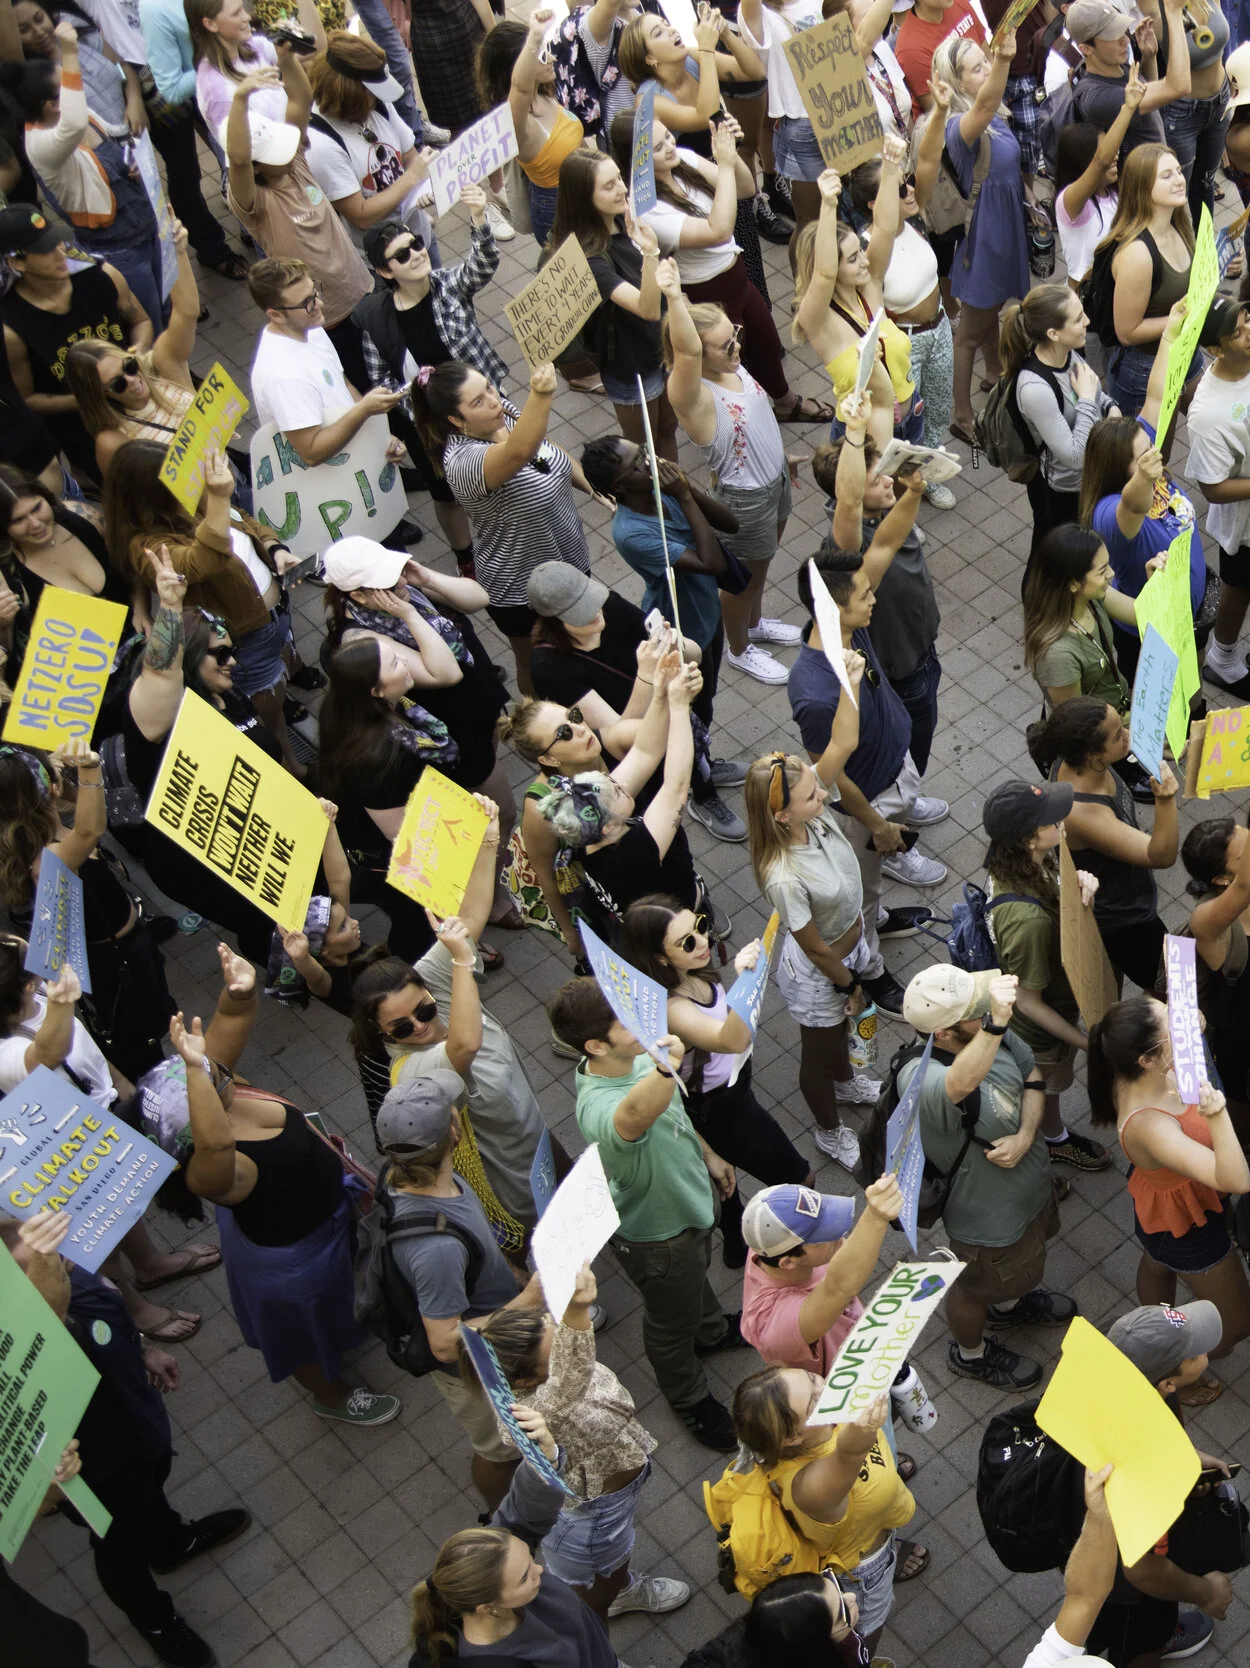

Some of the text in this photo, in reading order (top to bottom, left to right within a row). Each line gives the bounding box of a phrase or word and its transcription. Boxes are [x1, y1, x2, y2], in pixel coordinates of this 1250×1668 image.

[436, 110, 503, 178] PLANET
[446, 130, 512, 204] PROFIT
[457, 153, 477, 173] OVER
[510, 256, 566, 321] THERE'S NO
[515, 264, 580, 339] TIME TO WAIT
[524, 308, 561, 354] EVERY
[562, 297, 572, 312] 4
[529, 341, 555, 368] FOR
[166, 371, 225, 483] STAND FOR
[18, 618, 77, 731] NETZERO
[53, 628, 116, 737] SDSU!
[1206, 741, 1222, 765] A
[1210, 712, 1242, 736] NO
[159, 749, 200, 831] CLIMATE
[185, 784, 220, 851] CRISIS
[207, 804, 245, 870] WON'T
[235, 812, 272, 891] NEITHER
[259, 831, 297, 908] WILL WE.
[1167, 939, 1194, 1094] STUDENTS
[1185, 963, 1208, 1083] CHANGE
[9, 1113, 102, 1209] CLIMATE
[20, 1135, 53, 1167] GLOBAL
[40, 1125, 121, 1214] ALKOUT
[75, 1167, 117, 1212] SAN DIEGO
[70, 1152, 148, 1245] YOUTH DEMAND
[83, 1160, 159, 1253] CLIMATE ACTION
[20, 1331, 46, 1378] POWER
[818, 1337, 879, 1414] LOVE
[857, 1267, 928, 1333] YOUR
[1, 1475, 21, 1508] TAKE
[16, 1450, 33, 1477] THE
[28, 1420, 46, 1455] LEAP
[3, 1389, 48, 1473] PLANT-BASED
